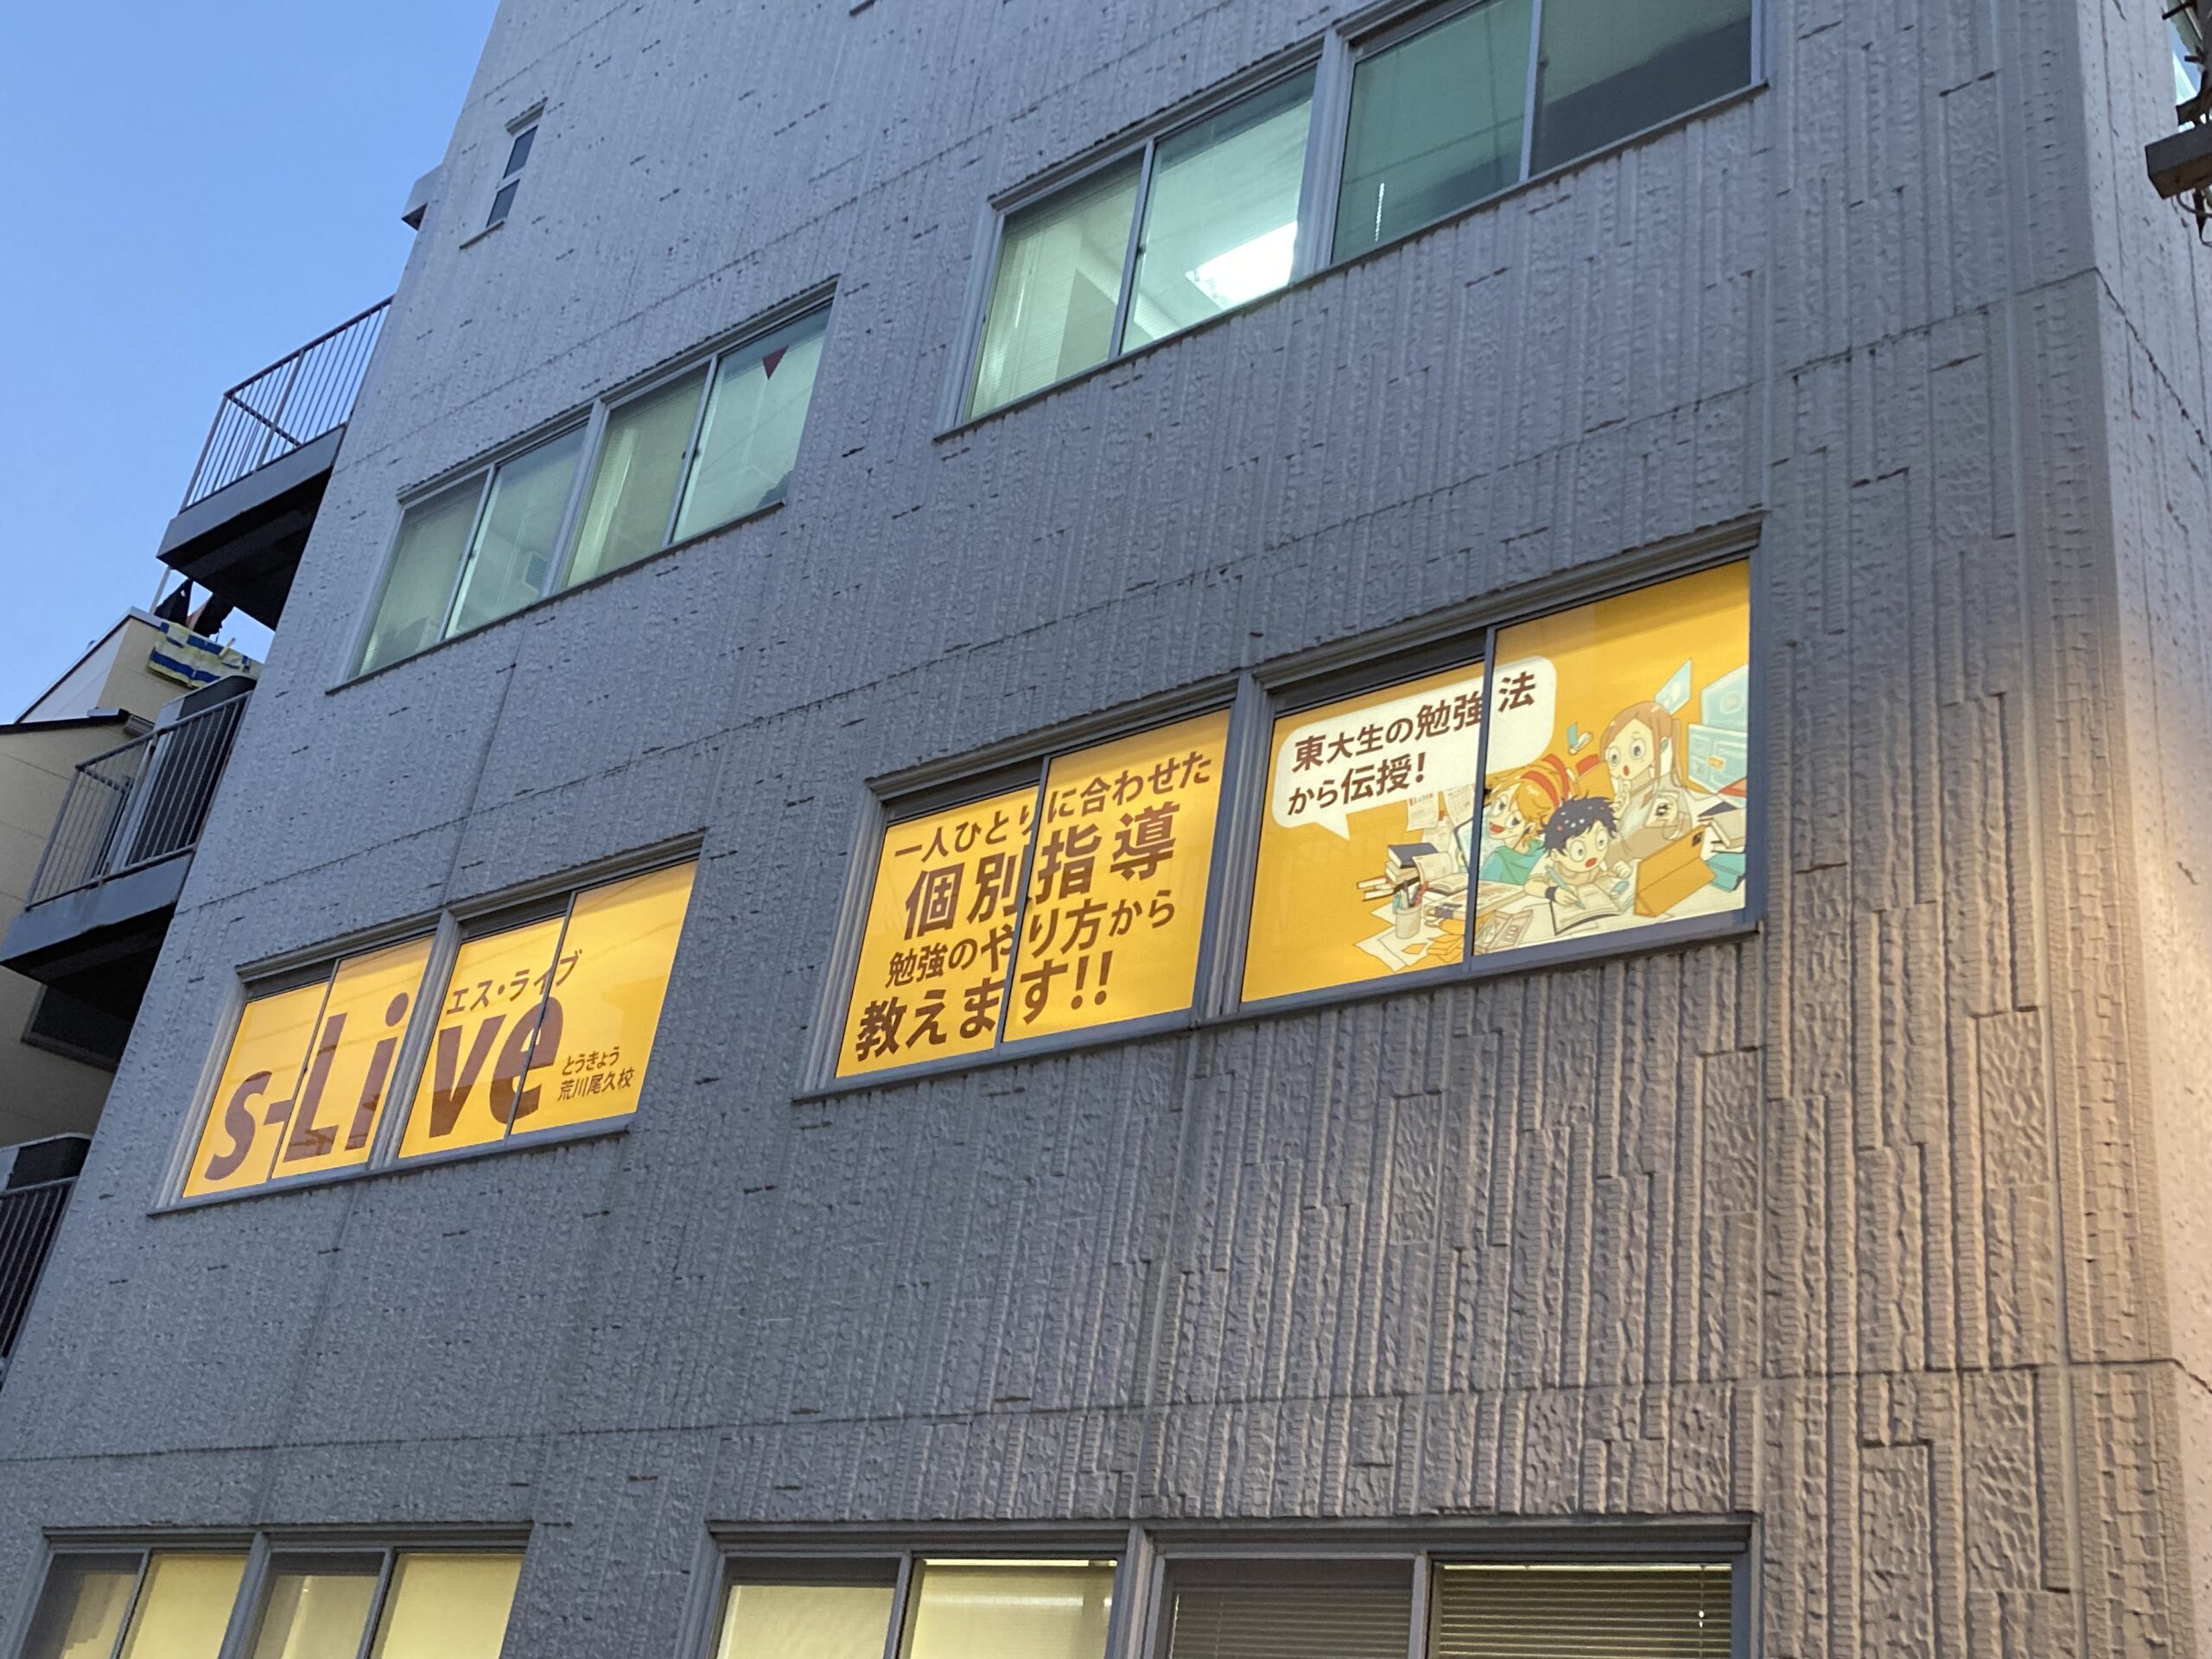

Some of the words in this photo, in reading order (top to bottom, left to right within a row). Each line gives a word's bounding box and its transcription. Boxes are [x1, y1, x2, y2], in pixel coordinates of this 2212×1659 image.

[1292, 671, 1536, 773] 東大生の勉強法
[1287, 752, 1427, 816] から伝授!
[903, 800, 1180, 940] 個別指導
[885, 889, 1176, 988] 勉強のやり方から
[446, 949, 582, 1015] エス・ライブ
[855, 950, 1114, 1062] 教えます!!
[556, 1065, 635, 1103] 荒川尾久校
[562, 1046, 620, 1077] とうきょう
